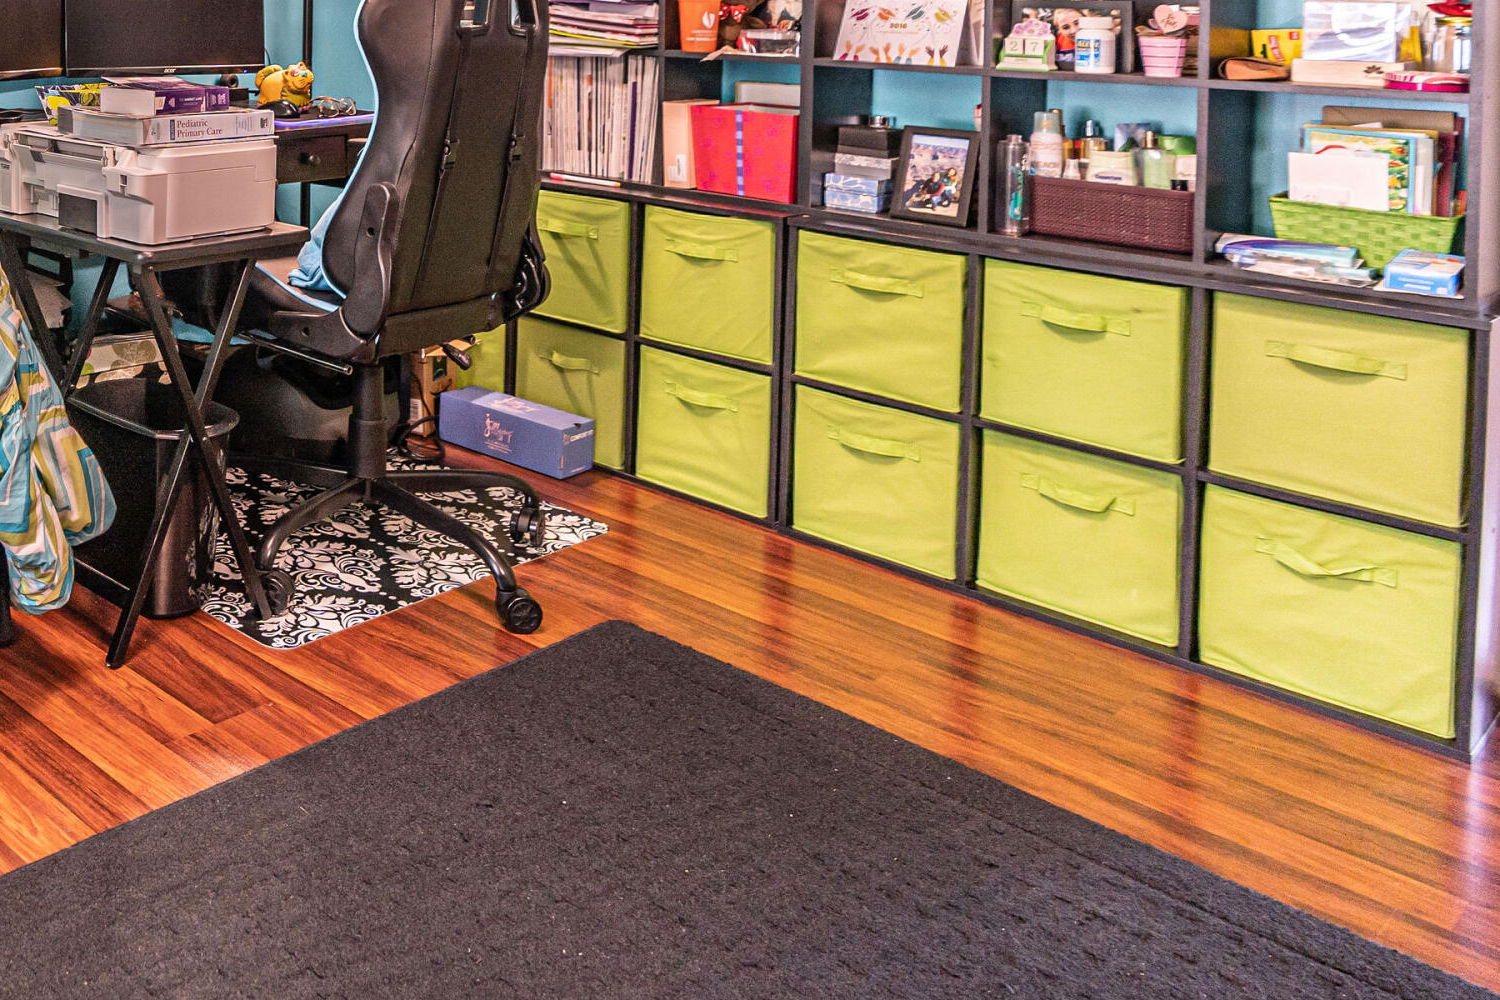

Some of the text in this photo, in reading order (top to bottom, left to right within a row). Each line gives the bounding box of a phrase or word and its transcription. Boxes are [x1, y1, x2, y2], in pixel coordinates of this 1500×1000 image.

[1010, 41, 1038, 52] 2 7
[177, 119, 208, 129] Pediatric
[177, 129, 205, 138] Primary
[206, 128, 223, 136] Care
